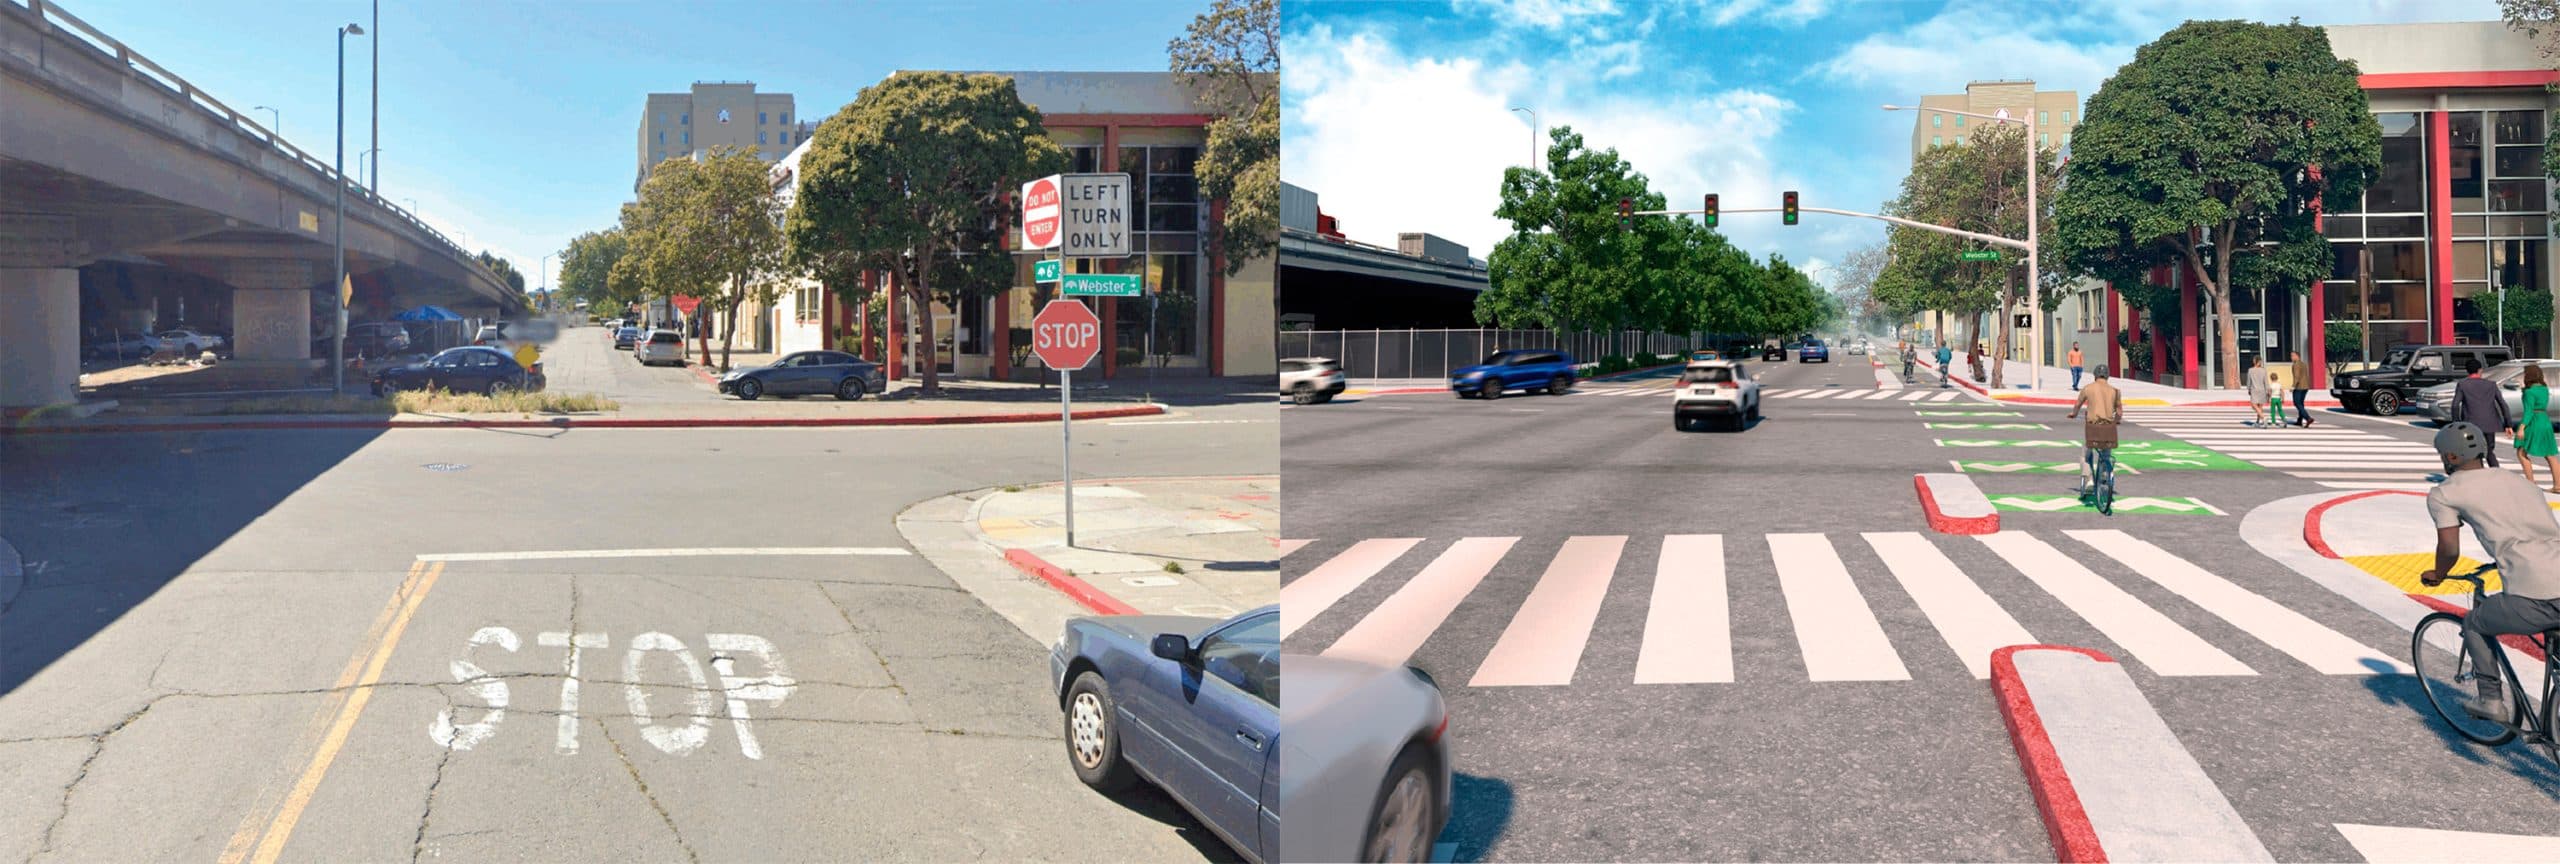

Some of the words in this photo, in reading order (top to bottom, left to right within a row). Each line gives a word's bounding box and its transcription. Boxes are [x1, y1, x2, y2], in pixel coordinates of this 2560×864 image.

[1028, 194, 1039, 207] DO
[1041, 190, 1056, 204] NOT
[1070, 185, 1121, 201] LEFT
[1071, 208, 1121, 224] TURN
[1031, 221, 1054, 236] ENTER
[1070, 232, 1122, 249] ONLY
[1078, 279, 1126, 293] Webster
[1039, 323, 1095, 349] STOP
[428, 626, 799, 761] STOP
